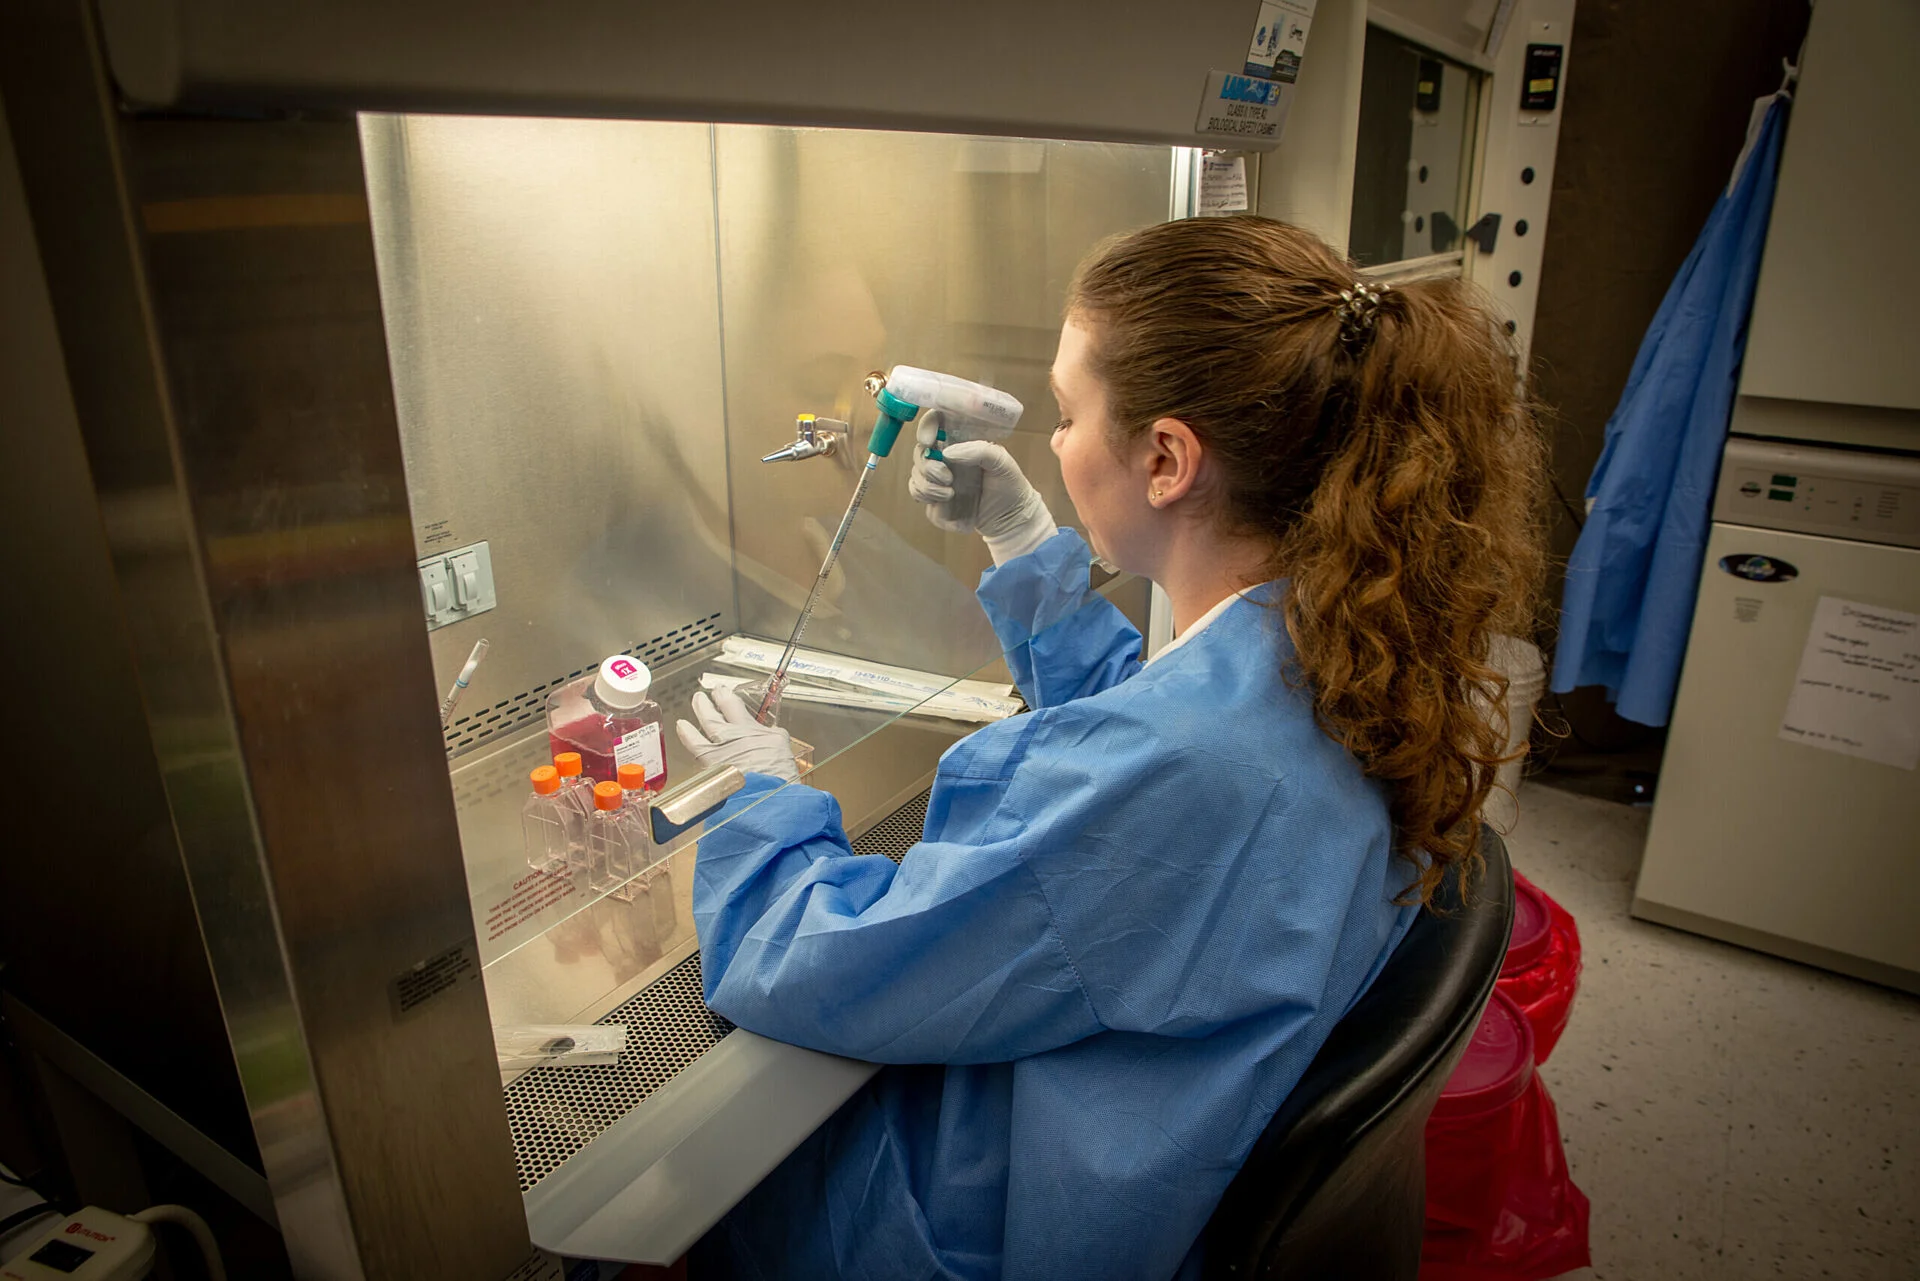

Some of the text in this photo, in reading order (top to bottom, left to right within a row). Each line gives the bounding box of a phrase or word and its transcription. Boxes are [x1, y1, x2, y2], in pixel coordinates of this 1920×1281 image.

[1227, 104, 1244, 117] CLASS
[1249, 106, 1262, 119] TYPE
[1207, 117, 1277, 135] BIOLOGICAL SAFETY CABINET
[744, 651, 765, 661] 5mL
[513, 869, 543, 890] CAUTION
